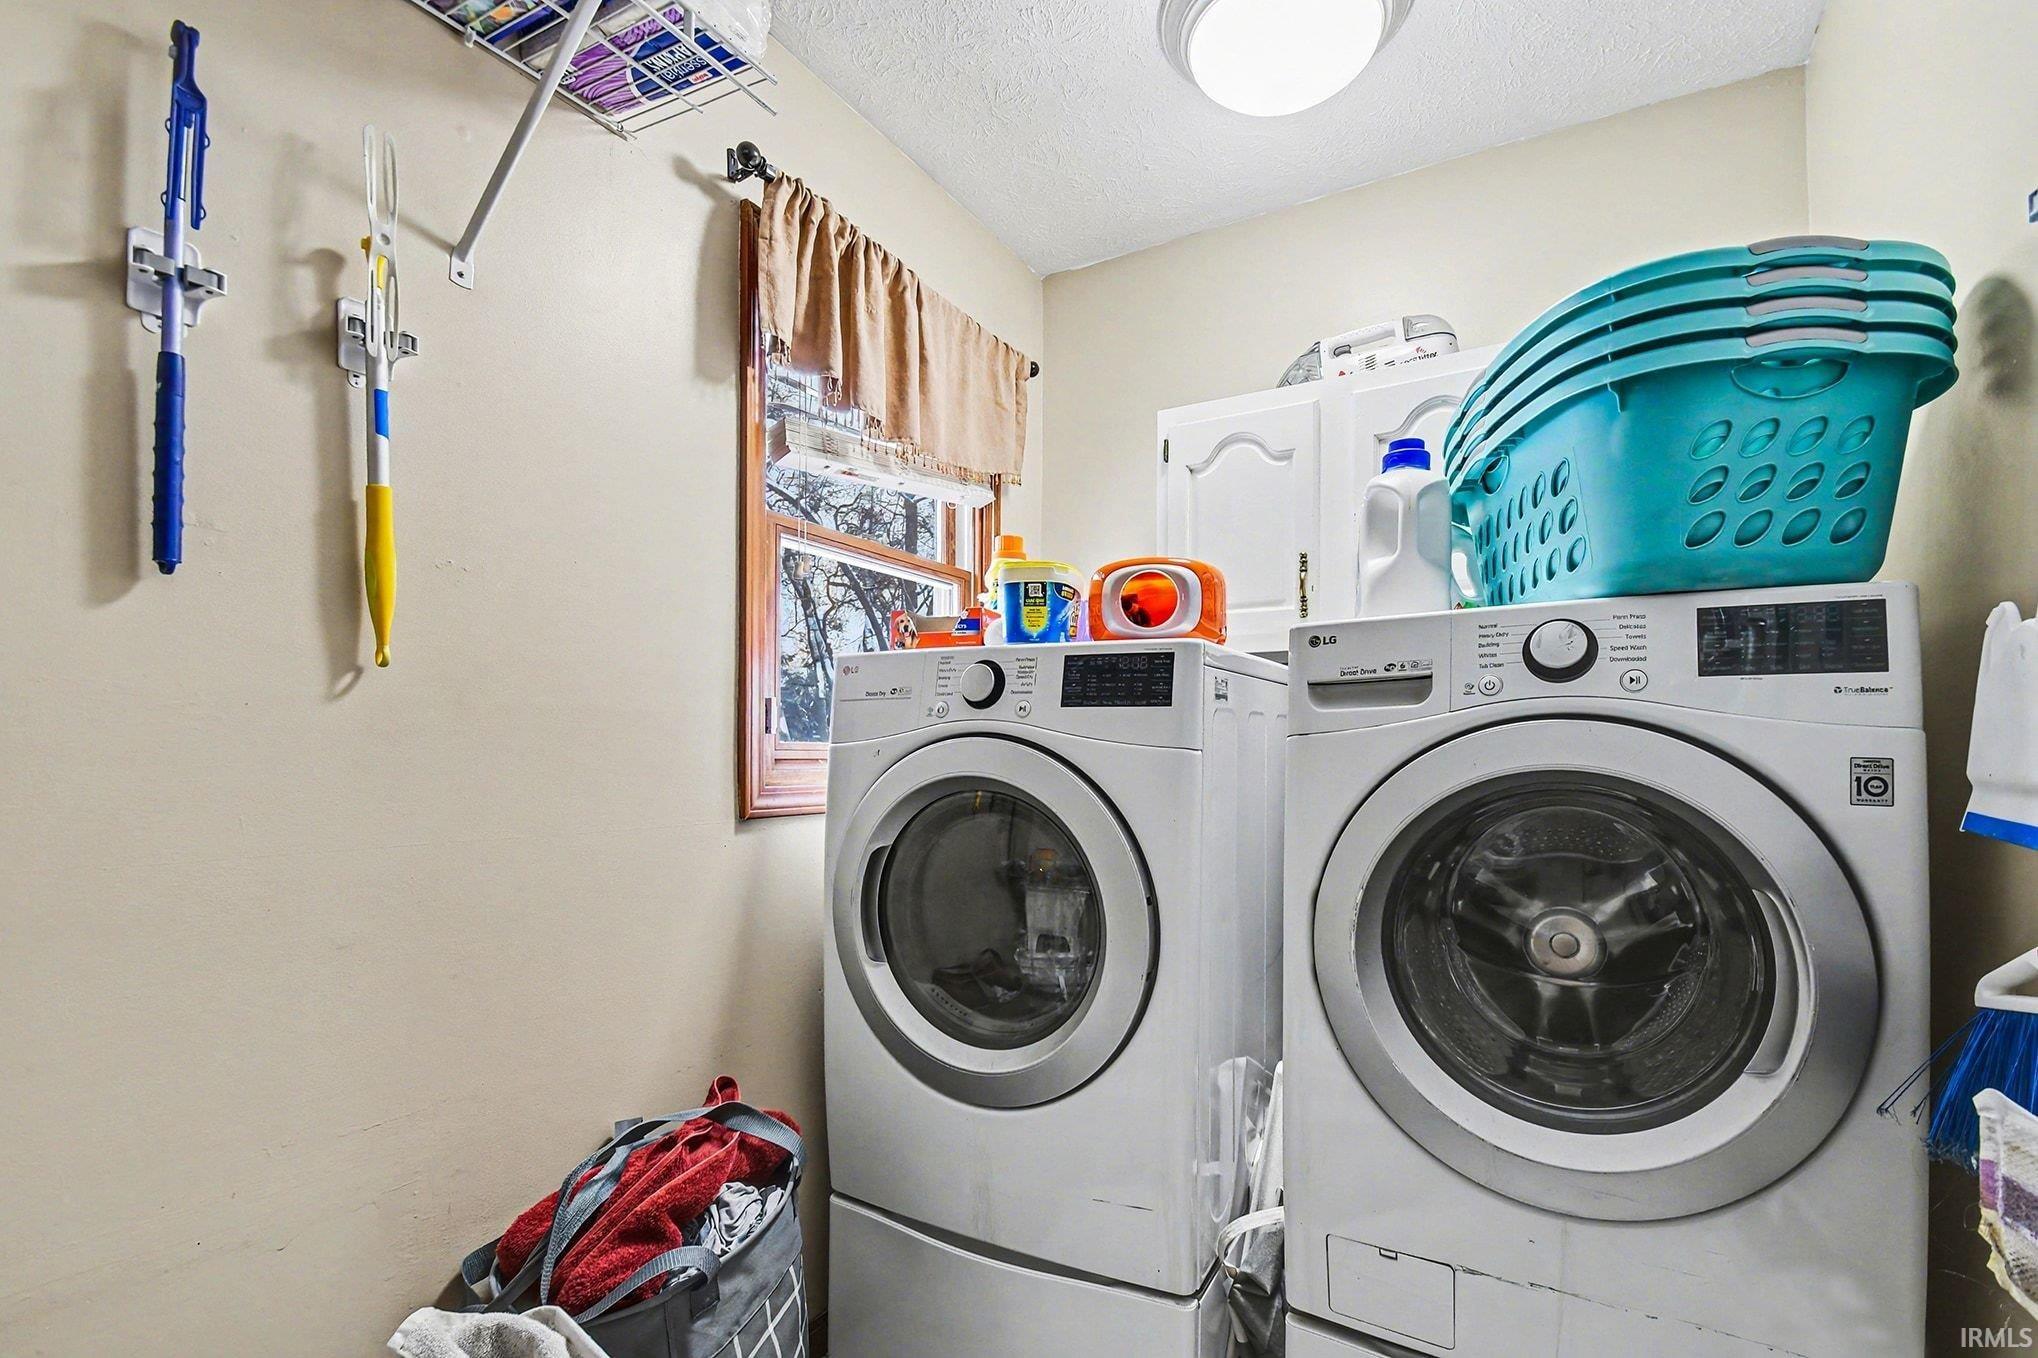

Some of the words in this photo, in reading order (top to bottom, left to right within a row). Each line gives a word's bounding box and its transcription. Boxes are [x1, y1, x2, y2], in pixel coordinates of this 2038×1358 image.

[646, 44, 692, 74] APKINS
[660, 55, 706, 83] ssential
[1322, 635, 1337, 645] LG
[1360, 668, 1377, 676] Drive
[1854, 776, 1889, 797] 10
